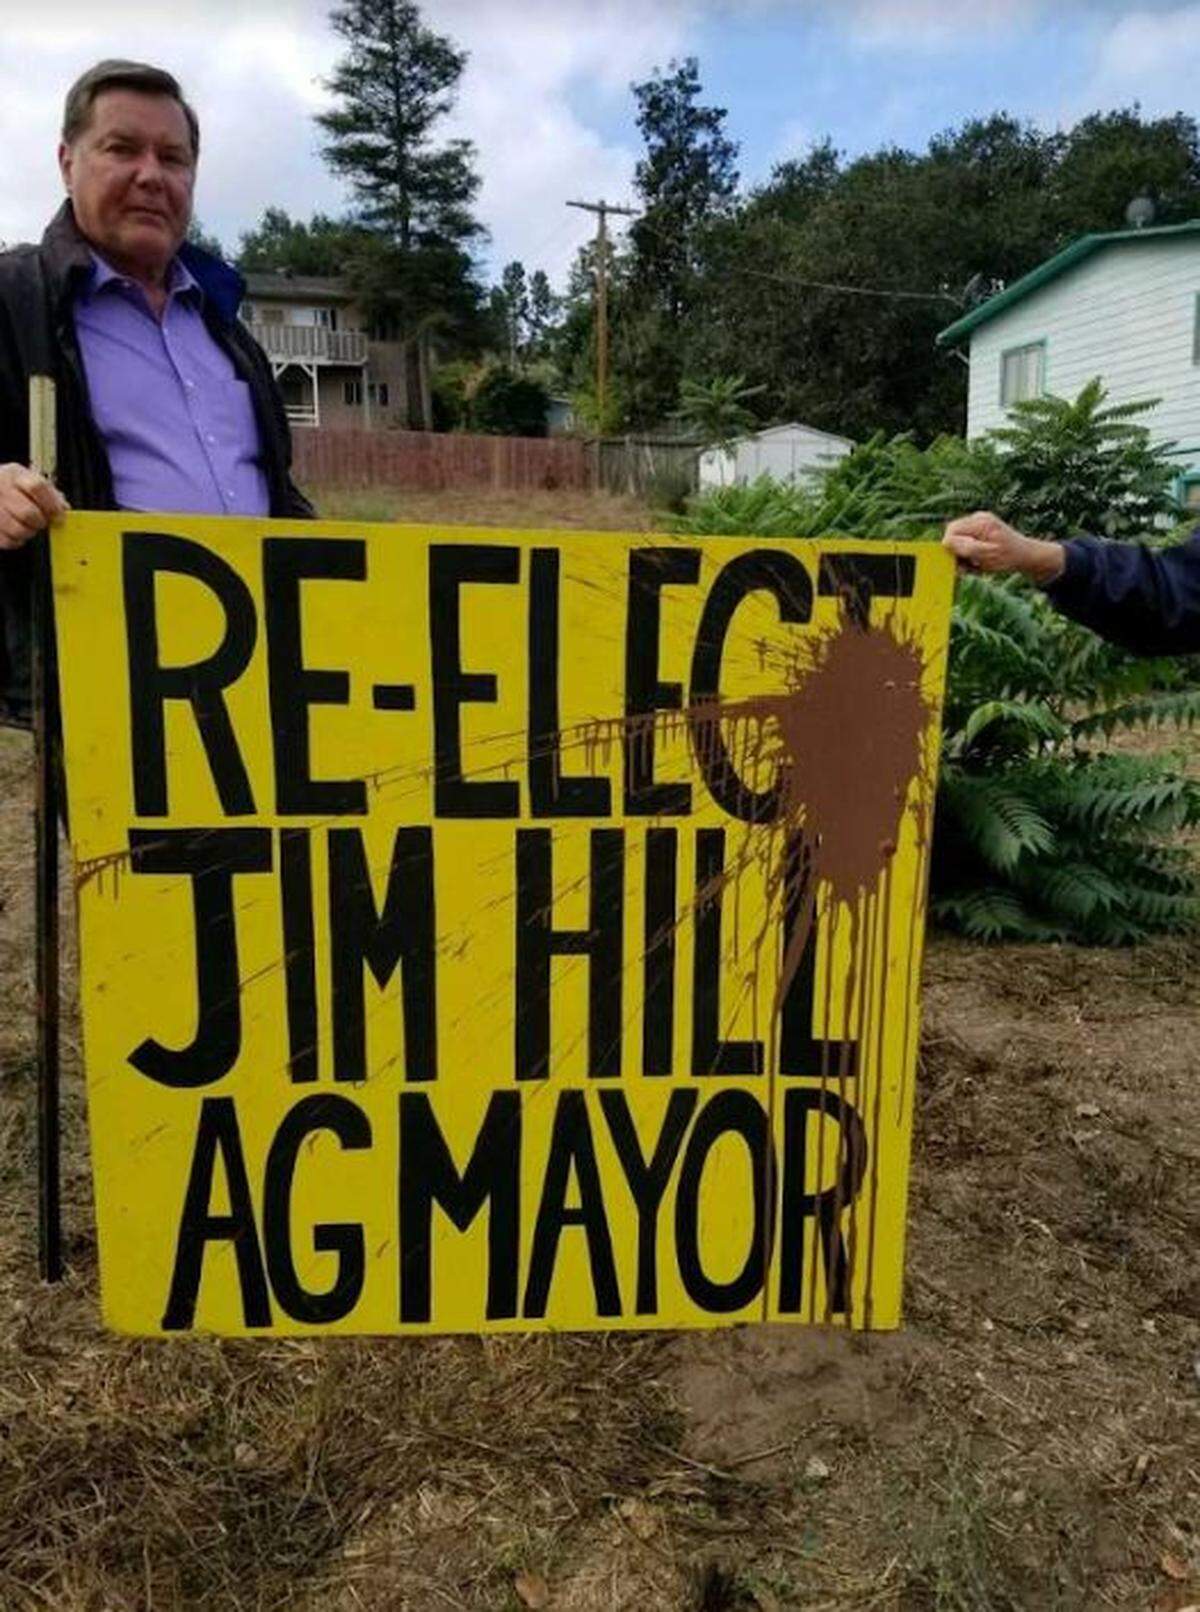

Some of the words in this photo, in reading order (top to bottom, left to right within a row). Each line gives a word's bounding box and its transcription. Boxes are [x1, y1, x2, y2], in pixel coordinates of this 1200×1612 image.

[122, 532, 916, 823] RE-ELECT
[127, 827, 437, 1087] JIM
[514, 828, 859, 1080] HILL
[161, 1093, 372, 1329] AG
[400, 1088, 868, 1323] MAYOR
